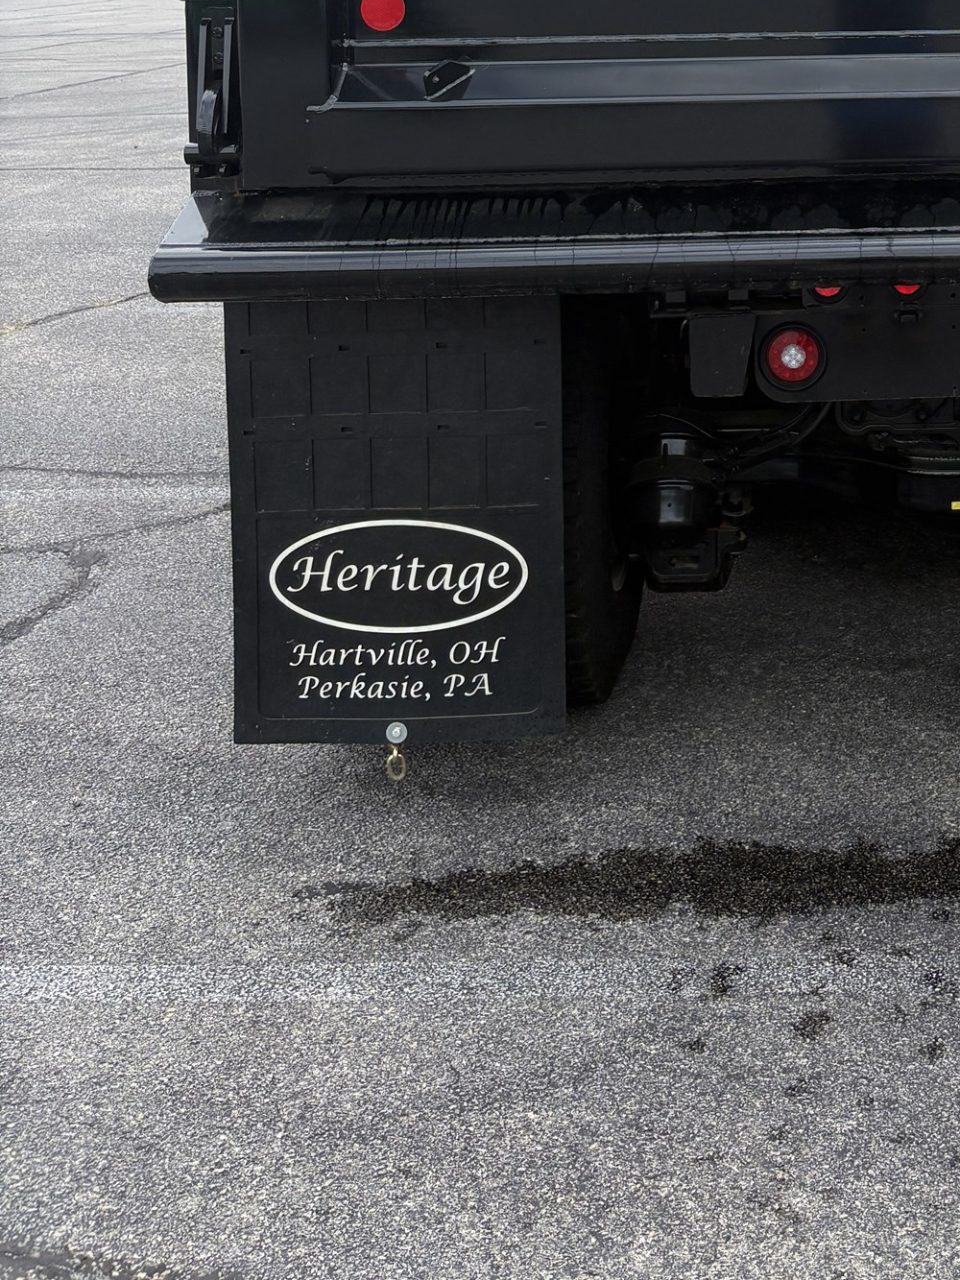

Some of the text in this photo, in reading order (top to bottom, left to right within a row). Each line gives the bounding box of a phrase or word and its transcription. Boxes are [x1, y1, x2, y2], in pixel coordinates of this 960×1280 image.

[286, 549, 511, 605] Heritage
[289, 636, 506, 669] Hartville, OH
[297, 672, 494, 702] Perkasie, PA
